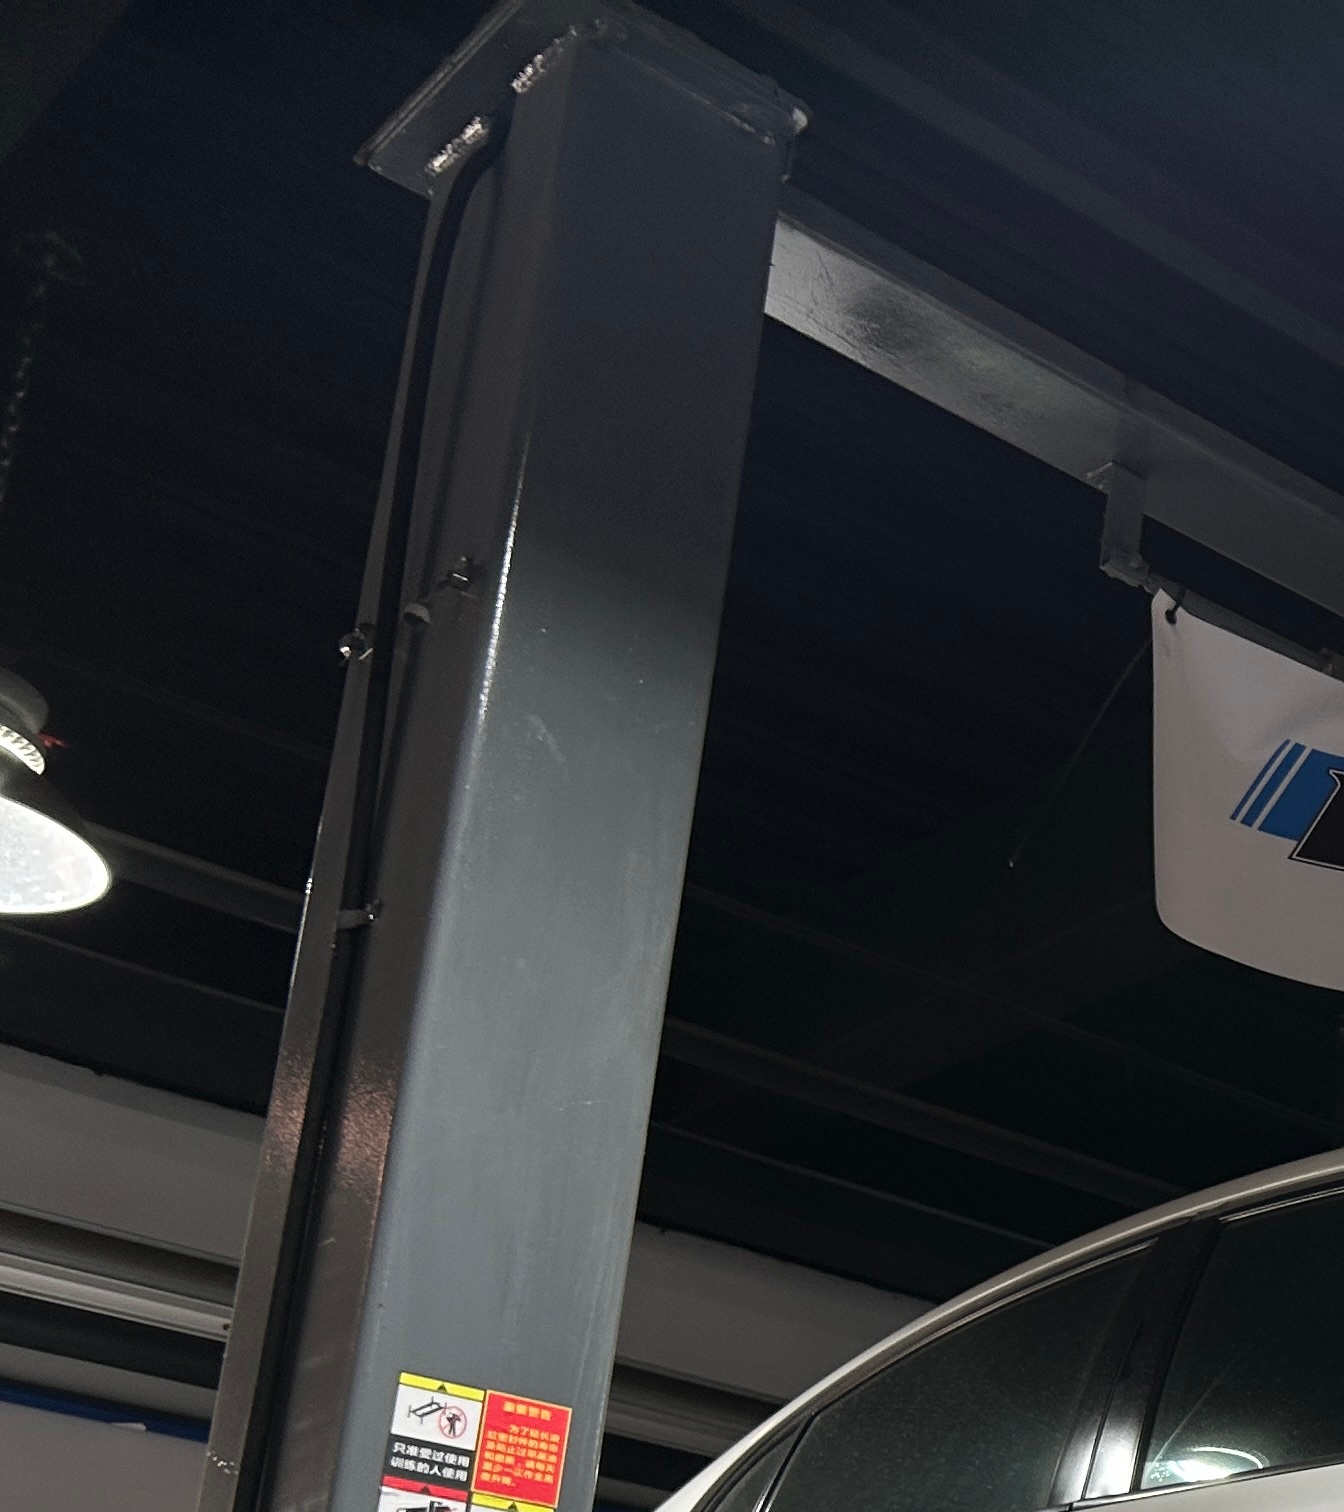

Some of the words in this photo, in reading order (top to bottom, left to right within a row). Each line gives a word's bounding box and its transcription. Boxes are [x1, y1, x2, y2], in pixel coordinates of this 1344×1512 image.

[390, 1456, 468, 1482] 训练的人使用
